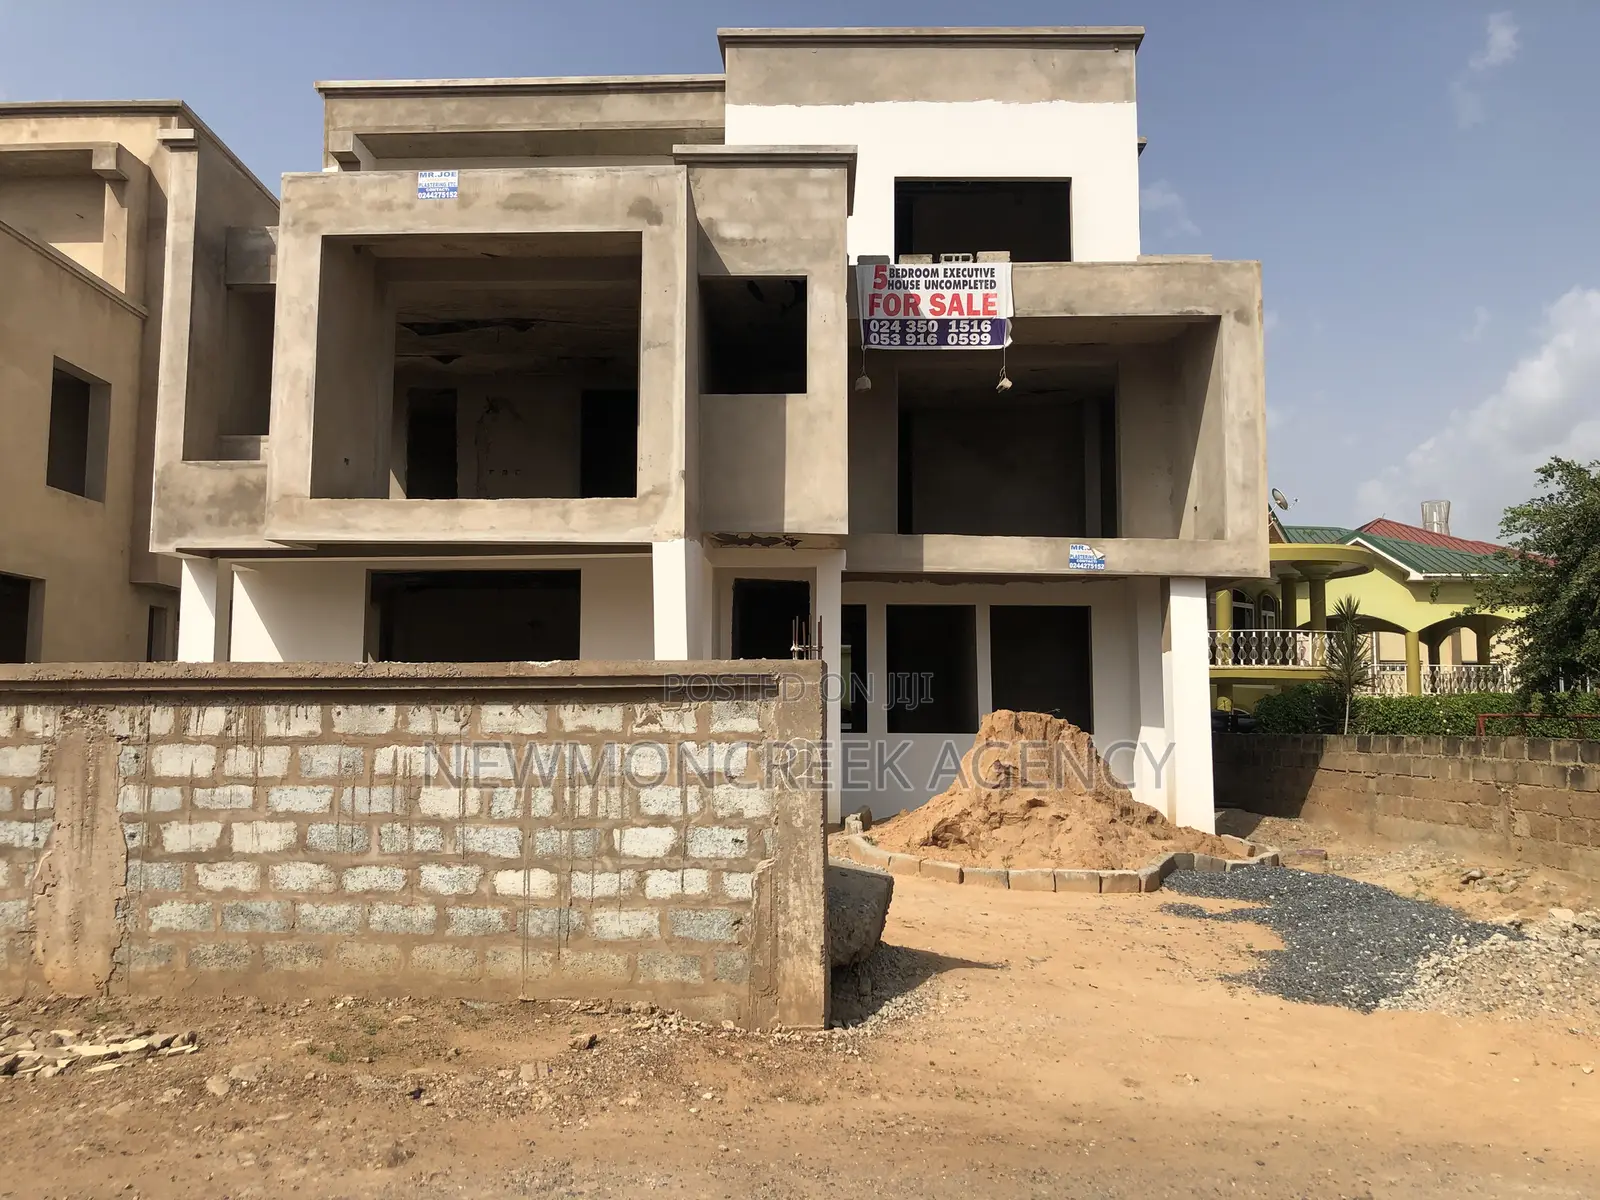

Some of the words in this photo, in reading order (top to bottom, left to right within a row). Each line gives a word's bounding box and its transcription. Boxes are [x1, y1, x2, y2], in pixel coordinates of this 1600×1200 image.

[418, 191, 458, 199] 0244275152
[873, 264, 888, 290] 5
[889, 268, 939, 278] BEDROOM
[943, 268, 995, 278] EXECUTIVE
[888, 279, 921, 290] HOUSE
[924, 279, 997, 290] UNCOMPLETED
[868, 293, 921, 317] FOR
[929, 293, 998, 317] SALE
[869, 320, 901, 333] 024
[906, 320, 939, 333] 350
[948, 320, 992, 333] 1516
[869, 333, 901, 345] 053
[905, 333, 938, 345] 916
[947, 333, 991, 345] 0599
